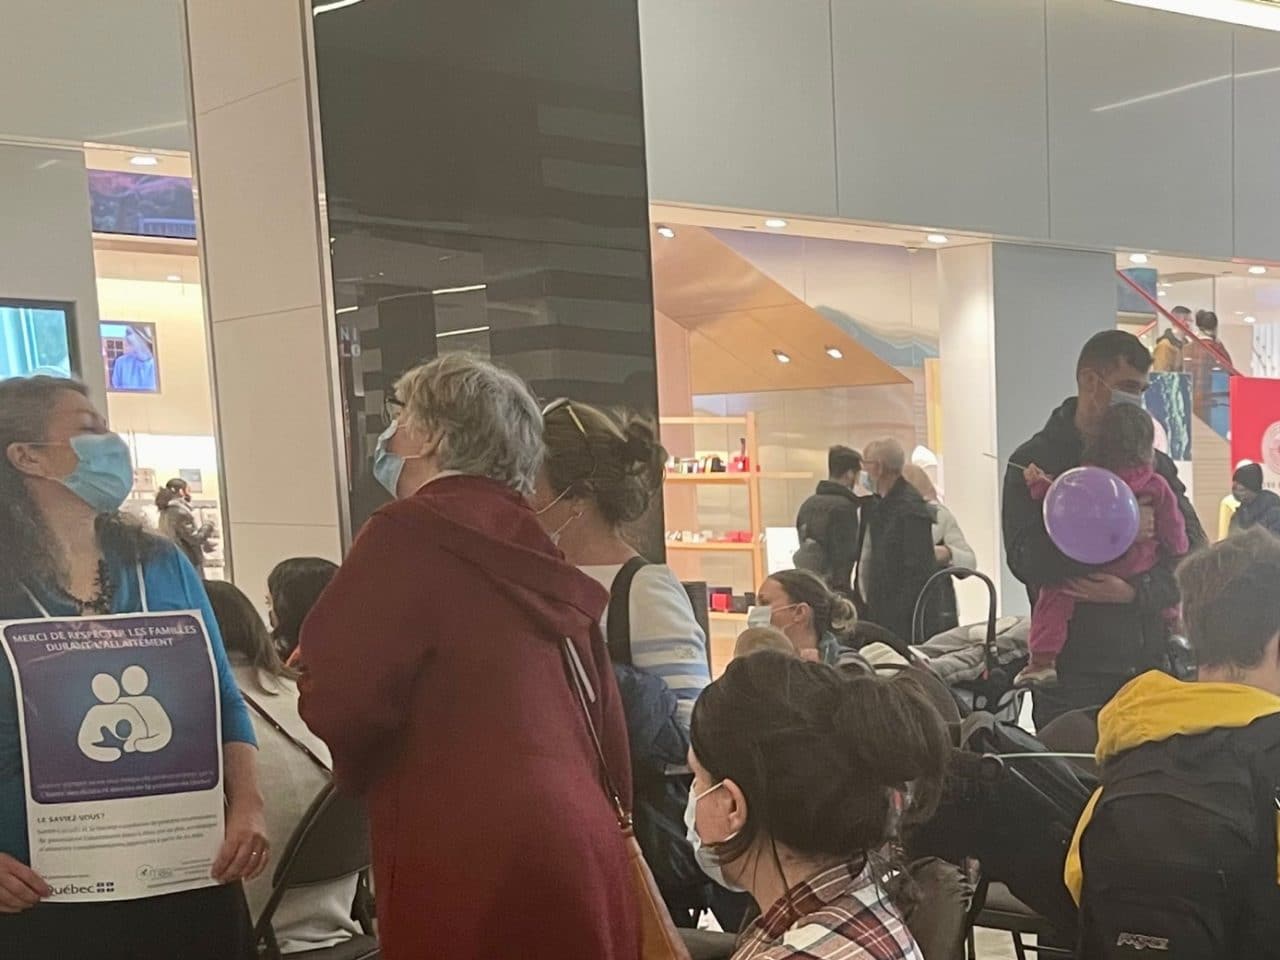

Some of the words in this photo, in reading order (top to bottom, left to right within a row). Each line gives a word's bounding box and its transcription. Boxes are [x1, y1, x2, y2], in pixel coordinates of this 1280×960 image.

[13, 633, 48, 643] MERCI
[50, 631, 66, 641] DE
[68, 629, 124, 640] RESPECTER
[128, 627, 147, 637] LES
[148, 625, 197, 636] FAMILLES
[46, 640, 91, 652] DURANT
